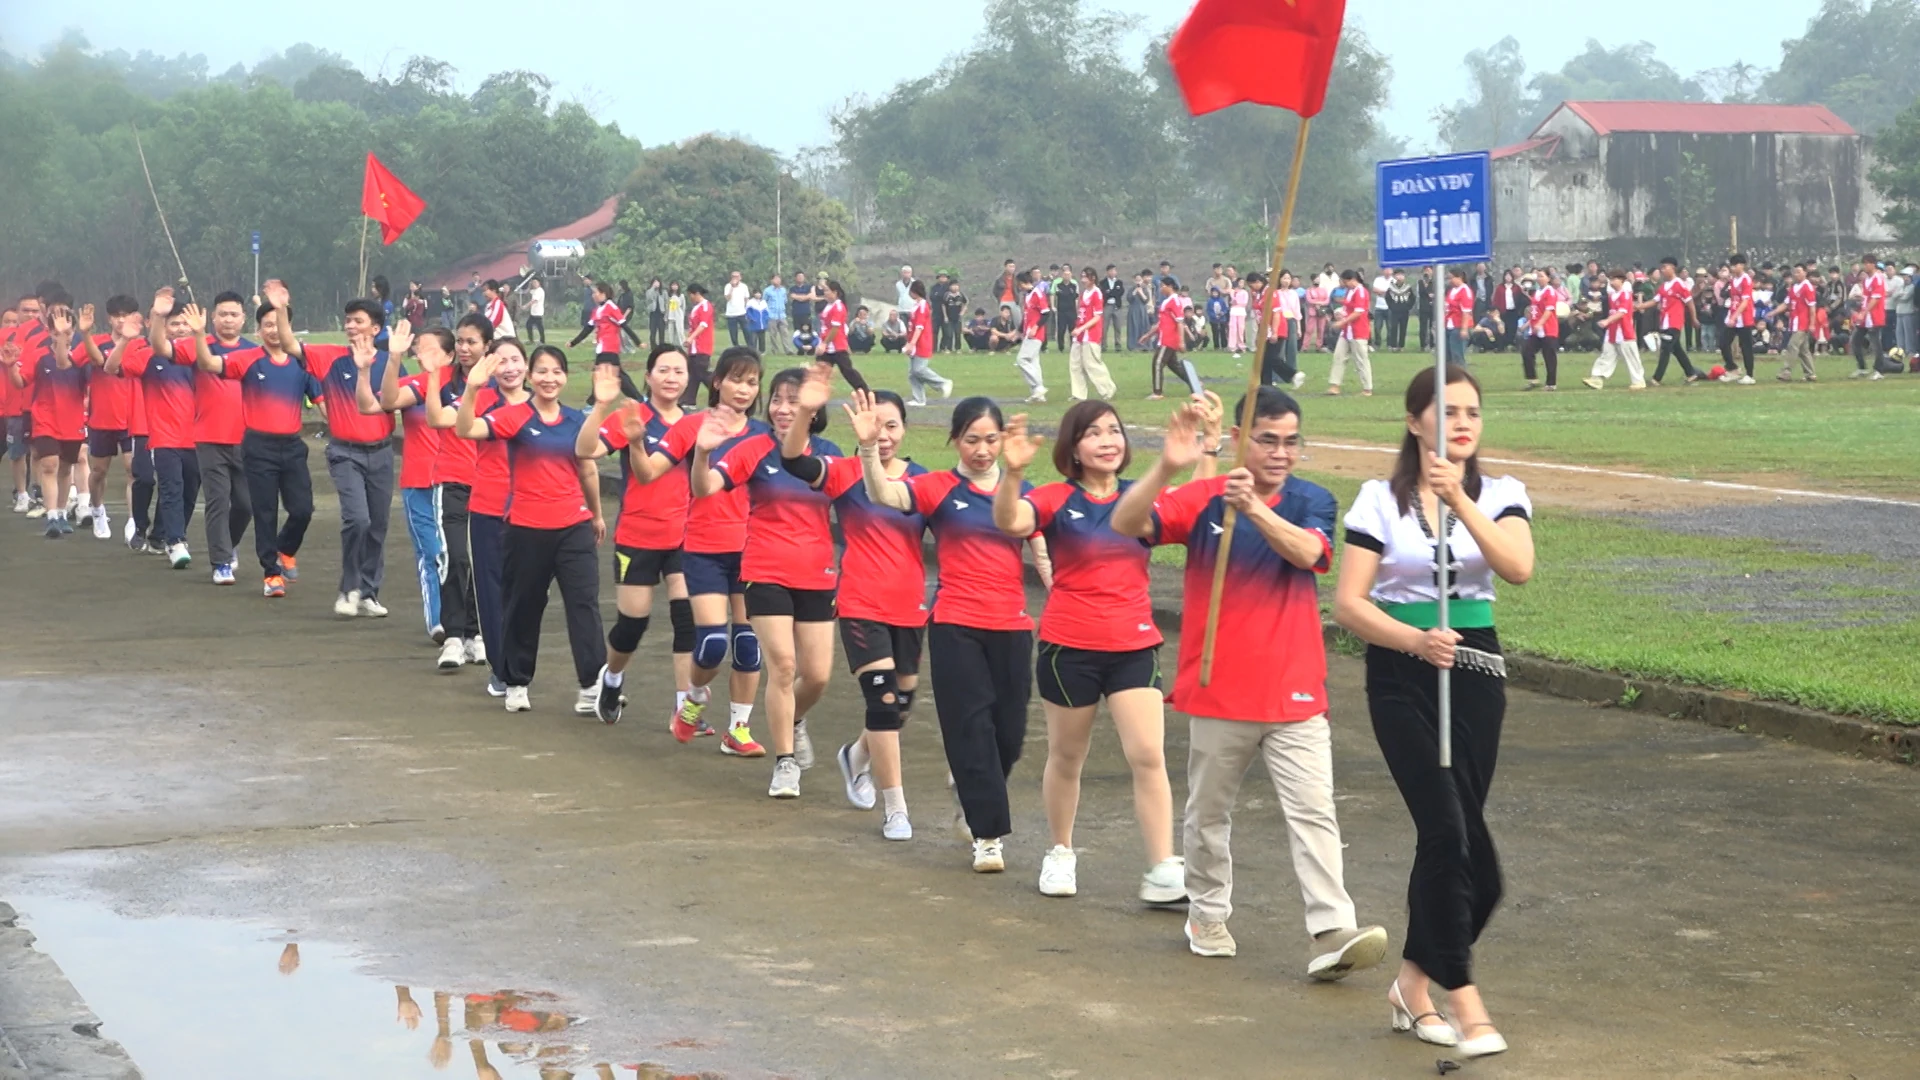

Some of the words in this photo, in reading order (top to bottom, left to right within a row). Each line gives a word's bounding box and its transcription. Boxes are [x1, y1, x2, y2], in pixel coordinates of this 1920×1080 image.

[1391, 173, 1436, 196] ĐOÀN
[1438, 173, 1475, 190] VĐV
[1421, 209, 1439, 246] LÊ
